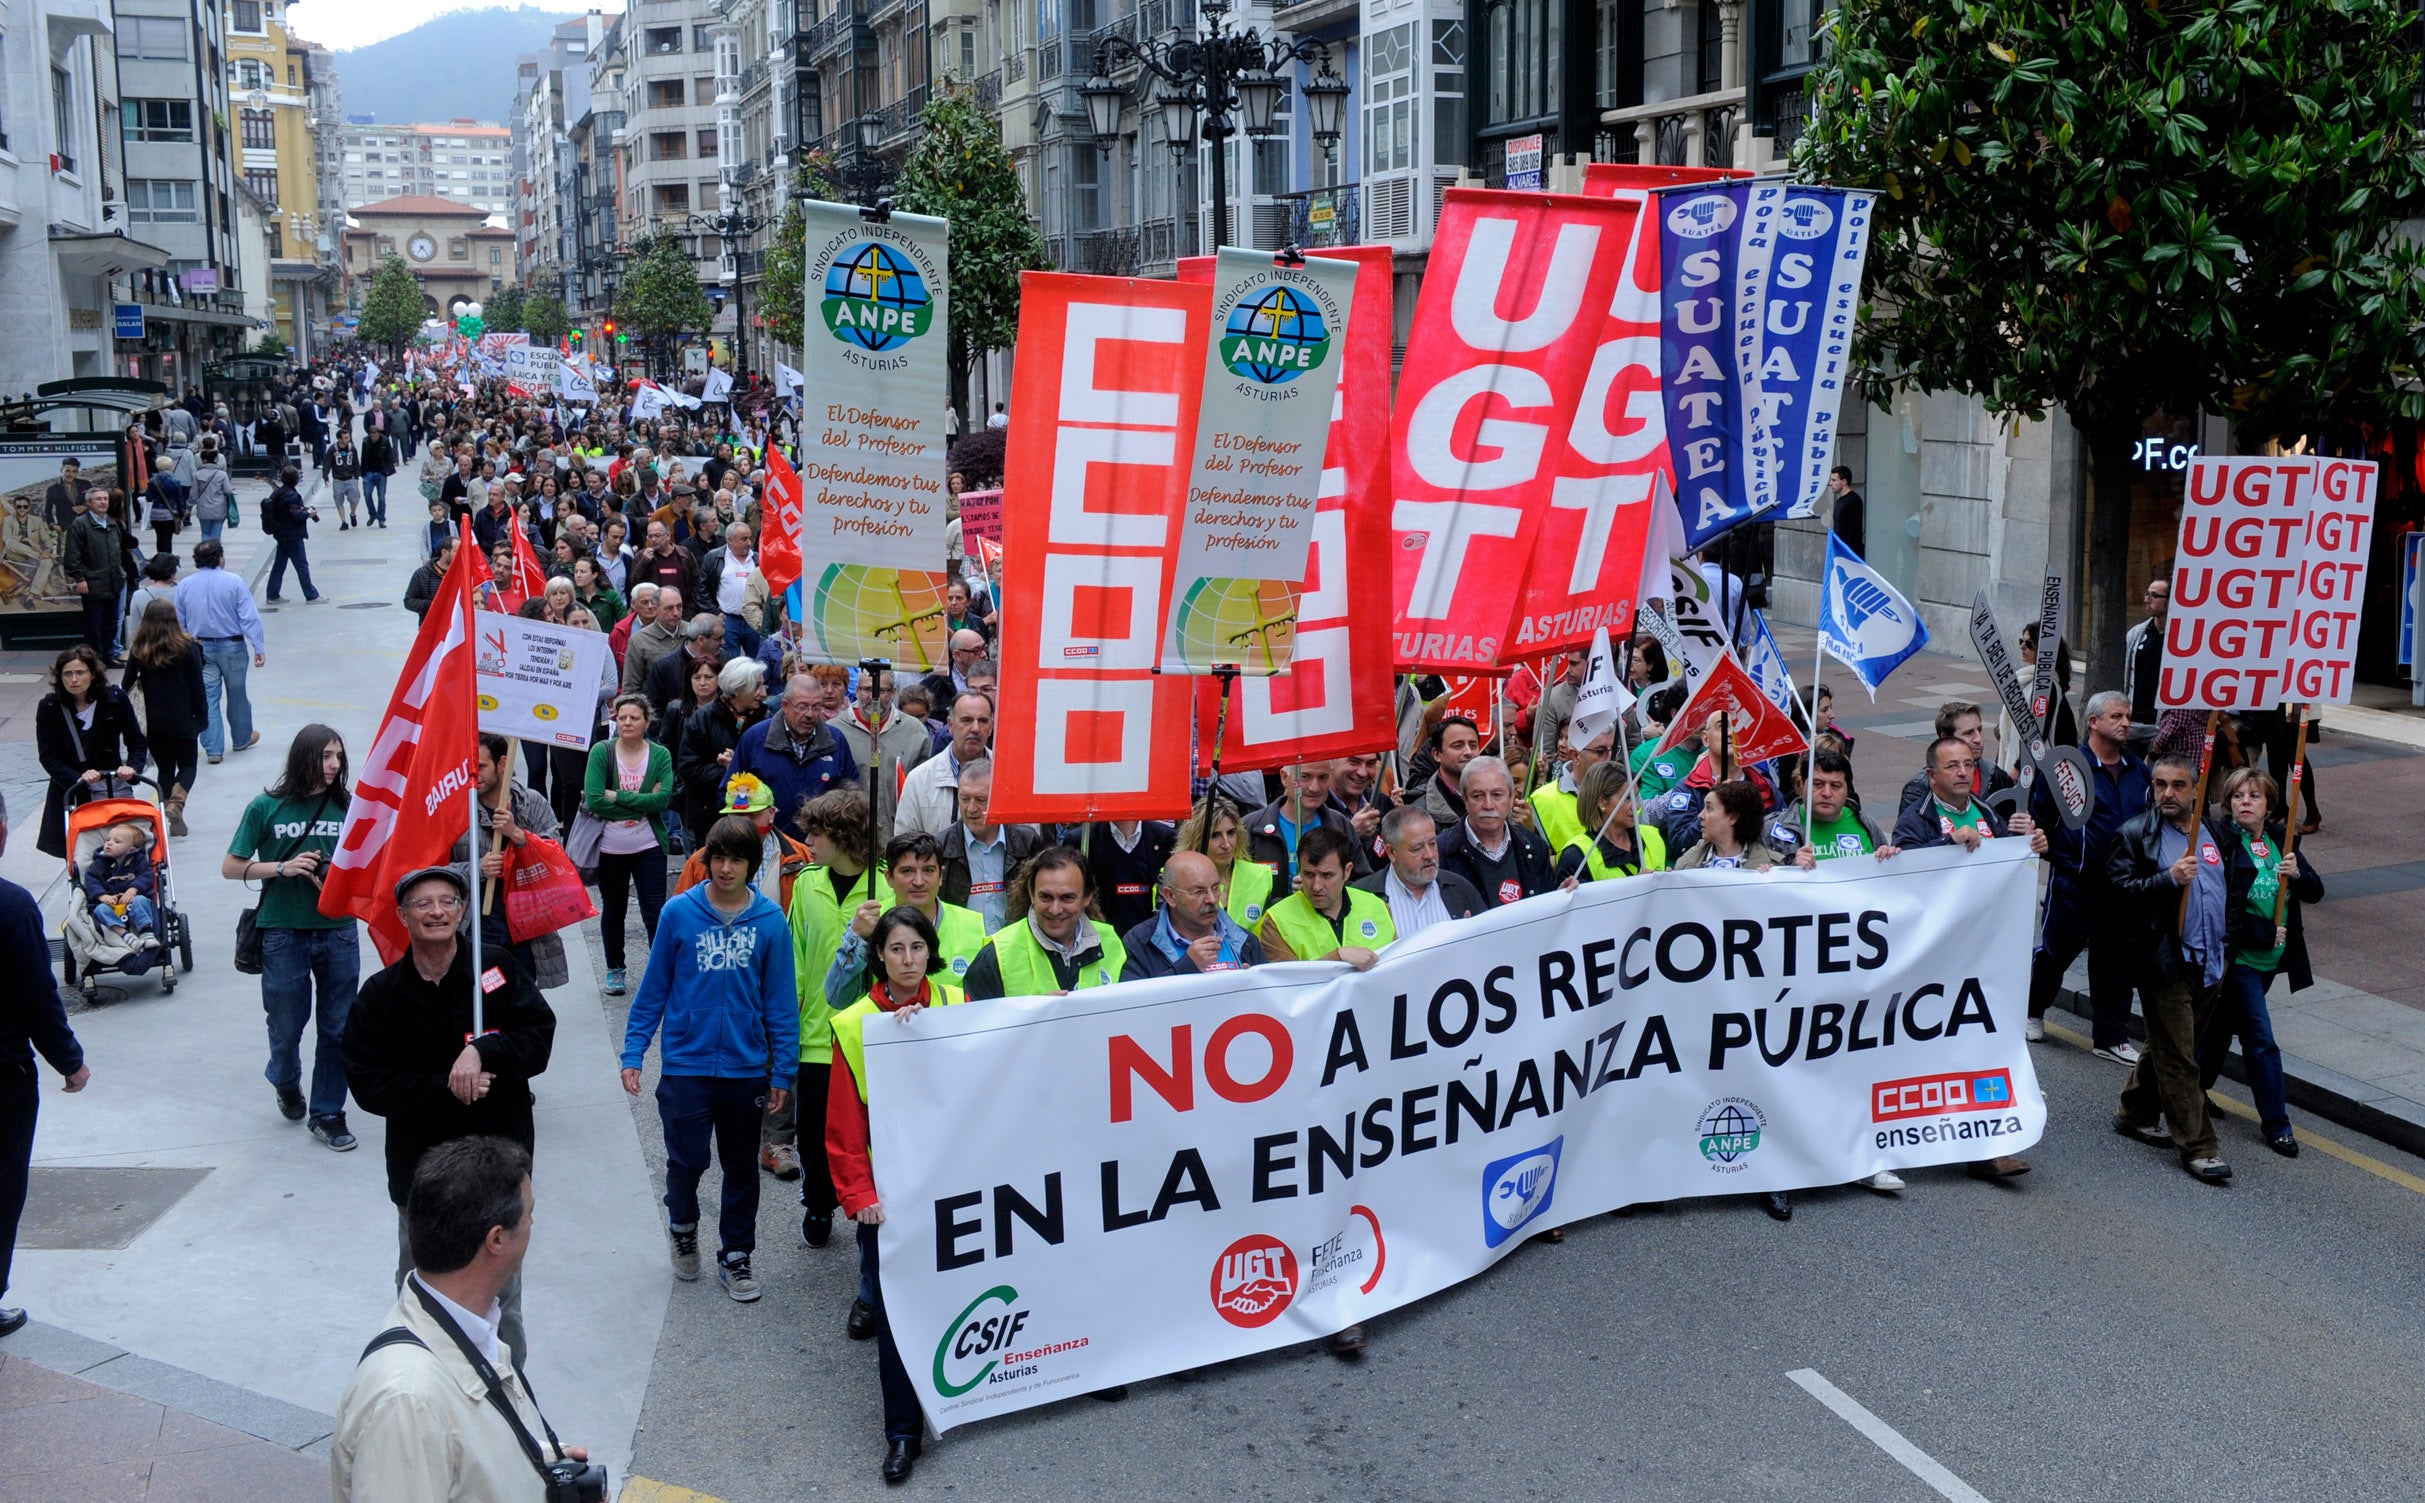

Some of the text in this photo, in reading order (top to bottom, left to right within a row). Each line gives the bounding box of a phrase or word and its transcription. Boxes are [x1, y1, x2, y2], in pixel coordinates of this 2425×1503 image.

[1507, 172, 1540, 190] ALVAREZ
[1681, 223, 1726, 238] SUATEA
[1749, 187, 1778, 248] pola
[1844, 198, 1869, 261] pola
[811, 226, 943, 297] SINDICATO INDEPENDIENTE
[835, 301, 916, 335] ANPE
[1215, 270, 1342, 334] SINDICATO INDEPENDIENTE
[1740, 267, 1760, 386] escuela
[1821, 282, 1853, 390] escuela
[842, 348, 908, 372] ASTURIAS
[1232, 338, 1312, 368] ANPE
[1235, 382, 1299, 402] ASTURIAS
[1673, 250, 1737, 531] SUATEA
[827, 404, 921, 433] El Defensor
[1393, 217, 1602, 622] UGT
[55, 444, 98, 452] HILFIGER
[821, 428, 926, 457] del Profesor
[1213, 433, 1302, 455] El Defensor
[807, 463, 940, 494] Defendemos tus
[1205, 454, 1303, 477] del Profesor
[1190, 487, 1312, 510] Defendemos tus
[2190, 464, 2311, 507] UGT
[817, 488, 930, 516] derechos y tu
[833, 515, 913, 537] profesión
[1194, 508, 1299, 532] derechos y tu
[1033, 302, 1187, 795] CCOO
[1205, 533, 1281, 552] profesión
[2182, 516, 2303, 558] UGT
[2174, 567, 2295, 609] UGT
[1516, 600, 1629, 645] ASTURIAS
[1639, 607, 1672, 646] RECORTES
[1980, 625, 1996, 645] TA
[2035, 575, 2061, 691] ENSEÑANZA PÚBLICA
[2167, 618, 2287, 659] UGT
[482, 652, 491, 661] NO
[1986, 639, 2006, 670] BIEN
[515, 673, 529, 682] TIERRA
[529, 675, 539, 683] POR
[540, 677, 549, 685] MAR
[553, 680, 562, 688] POR
[562, 681, 572, 689] AIRE
[1998, 663, 2012, 684] DE
[2159, 667, 2279, 707] UGT
[2003, 681, 2035, 737] RECORTES
[556, 734, 577, 742] CCOO
[2054, 758, 2085, 813] FETE-UGT
[970, 885, 994, 893] CCOO
[1117, 885, 1139, 894] CCOO
[1501, 882, 1520, 896] UGT
[1108, 911, 1889, 1123] NO A LOS RECORTES
[1878, 1078, 1967, 1115] CCOO
[935, 976, 1997, 1272] EN LA ENSEÑANZA PÚBLICA
[1695, 1096, 1768, 1132] SINDICATO INDEPENDIENTE
[1707, 1137, 1751, 1153] ANPE
[1874, 1115, 2024, 1151] enseñanza
[1711, 1161, 1749, 1174] ASTURIAS
[1312, 1231, 1344, 1267] FETE
[1221, 1246, 1285, 1292] UGT
[1311, 1248, 1363, 1283] Enseñanza
[1308, 1275, 1338, 1294] ASTURIAS
[955, 1310, 1030, 1360] CSIF
[1004, 1337, 1089, 1365] Enseñanza
[988, 1364, 1038, 1385] Asturias
[939, 1403, 960, 1414] Central
[961, 1395, 985, 1408] Sindical
[986, 1385, 1028, 1401] Independiente
[1034, 1380, 1042, 1389] de
